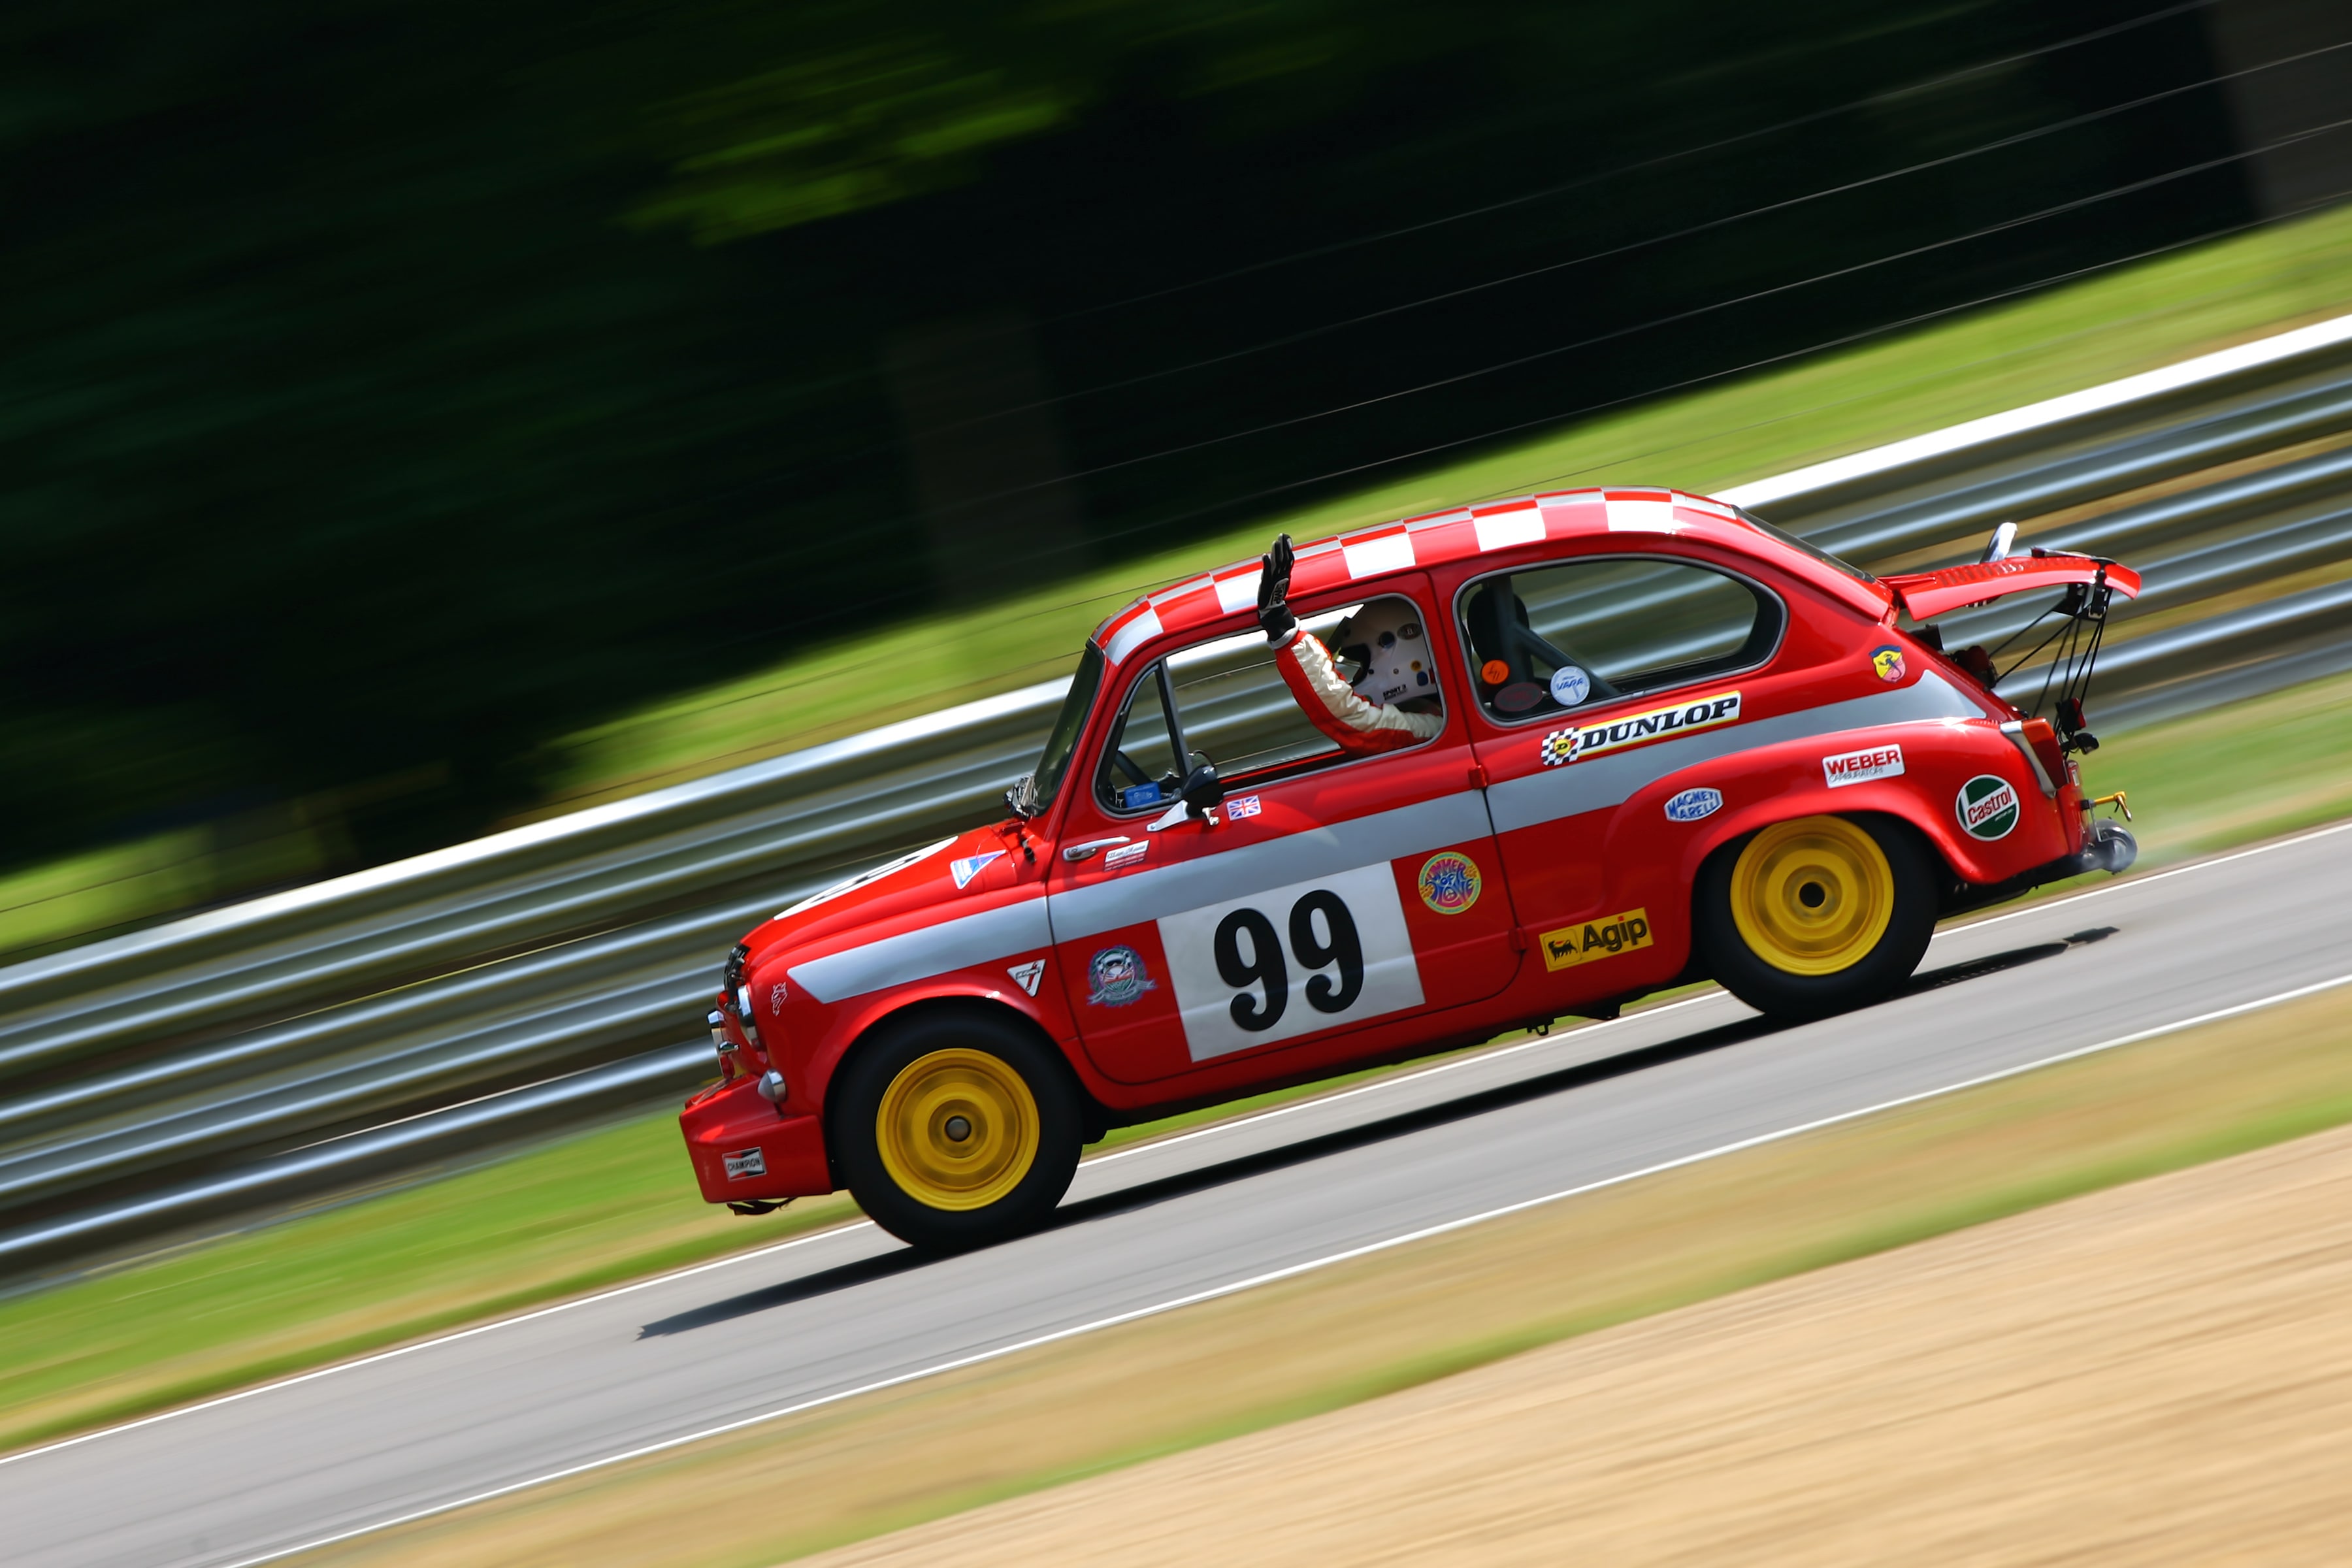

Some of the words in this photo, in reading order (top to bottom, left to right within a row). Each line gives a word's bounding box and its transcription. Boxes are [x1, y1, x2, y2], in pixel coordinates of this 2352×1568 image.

[1578, 698, 1738, 751] DUNLOP
[1826, 749, 1900, 775] WEBER
[1968, 787, 2012, 825] Castrol
[1582, 915, 1648, 953] Agip
[1214, 889, 1364, 1032] 99
[727, 1158, 760, 1172] CHAMPION
